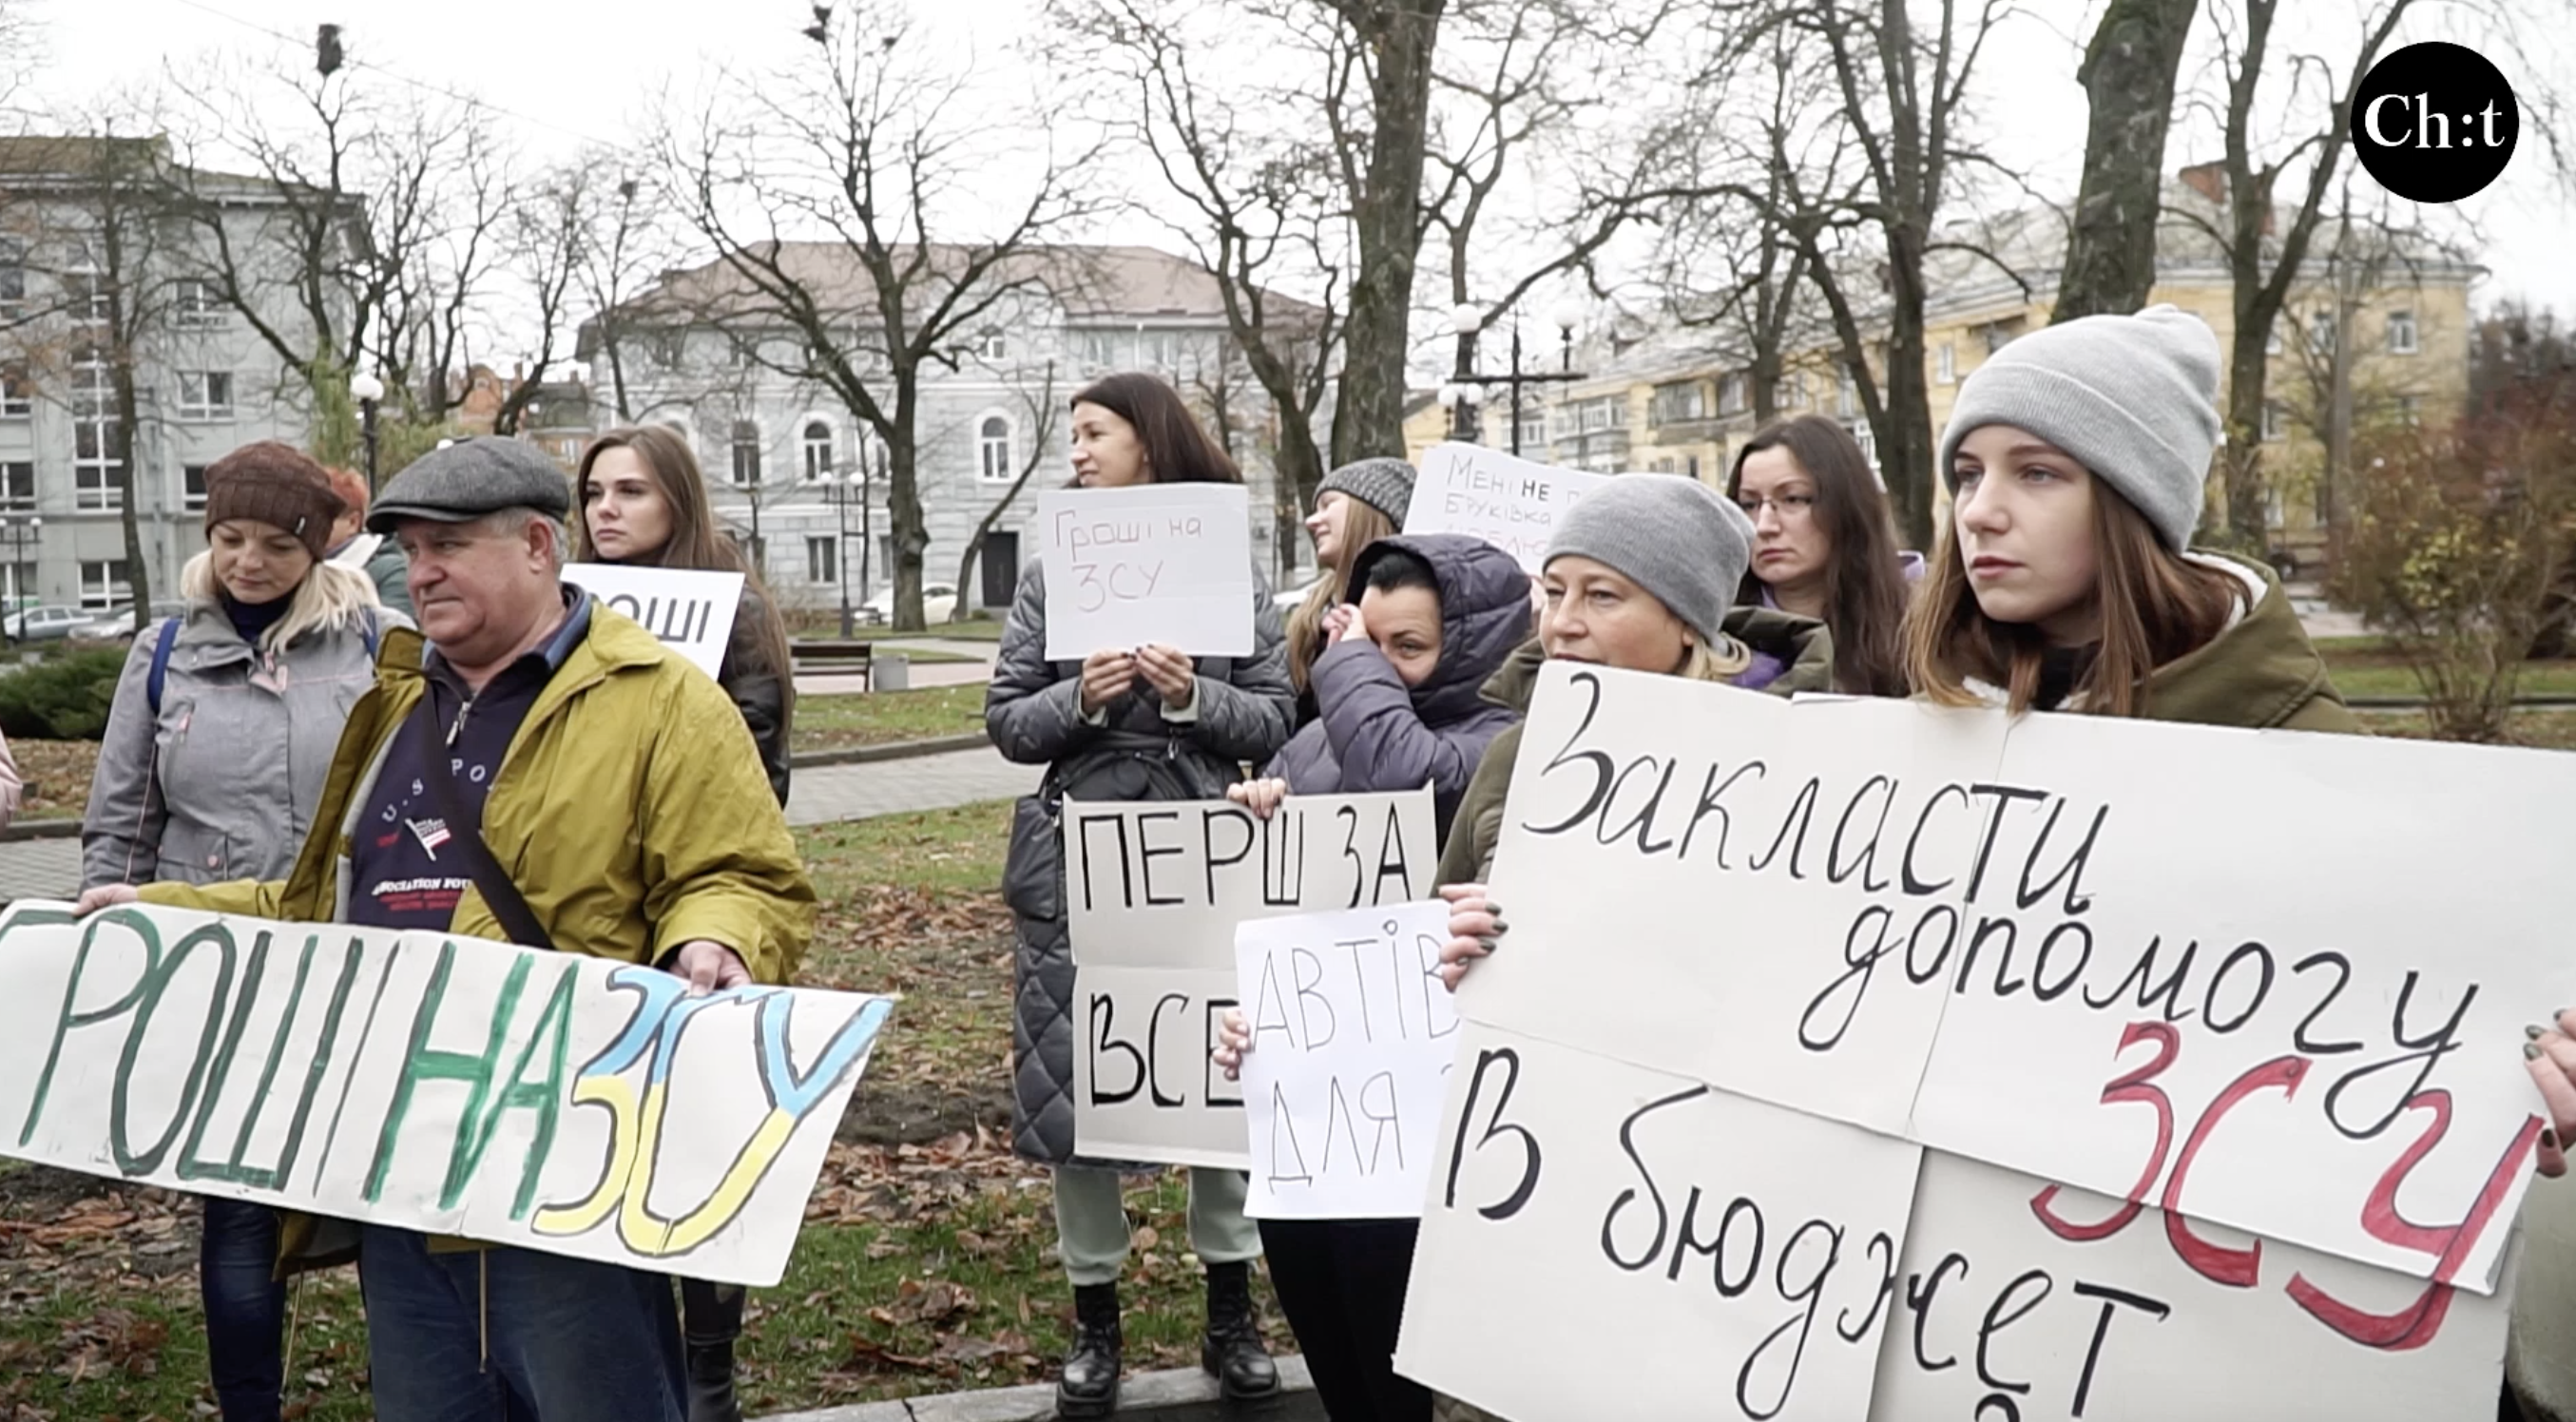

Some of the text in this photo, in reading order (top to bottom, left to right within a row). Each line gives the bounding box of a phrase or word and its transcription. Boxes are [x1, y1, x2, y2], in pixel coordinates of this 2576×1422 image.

[1168, 516, 1202, 539] на
[1521, 478, 1552, 503] НЕ
[1070, 559, 1164, 613] ЗСУ
[1079, 800, 1413, 912] ПЕРШ ЗА
[1521, 671, 2109, 913] Закласти
[362, 940, 581, 1220] НА
[529, 965, 894, 1258] ЗСУ
[1798, 902, 2480, 1140] допомогу
[1268, 1070, 1405, 1194] ДЛЯ
[2029, 1021, 2547, 1351] ЗСУ
[1444, 1047, 2171, 1421] В бюджет
